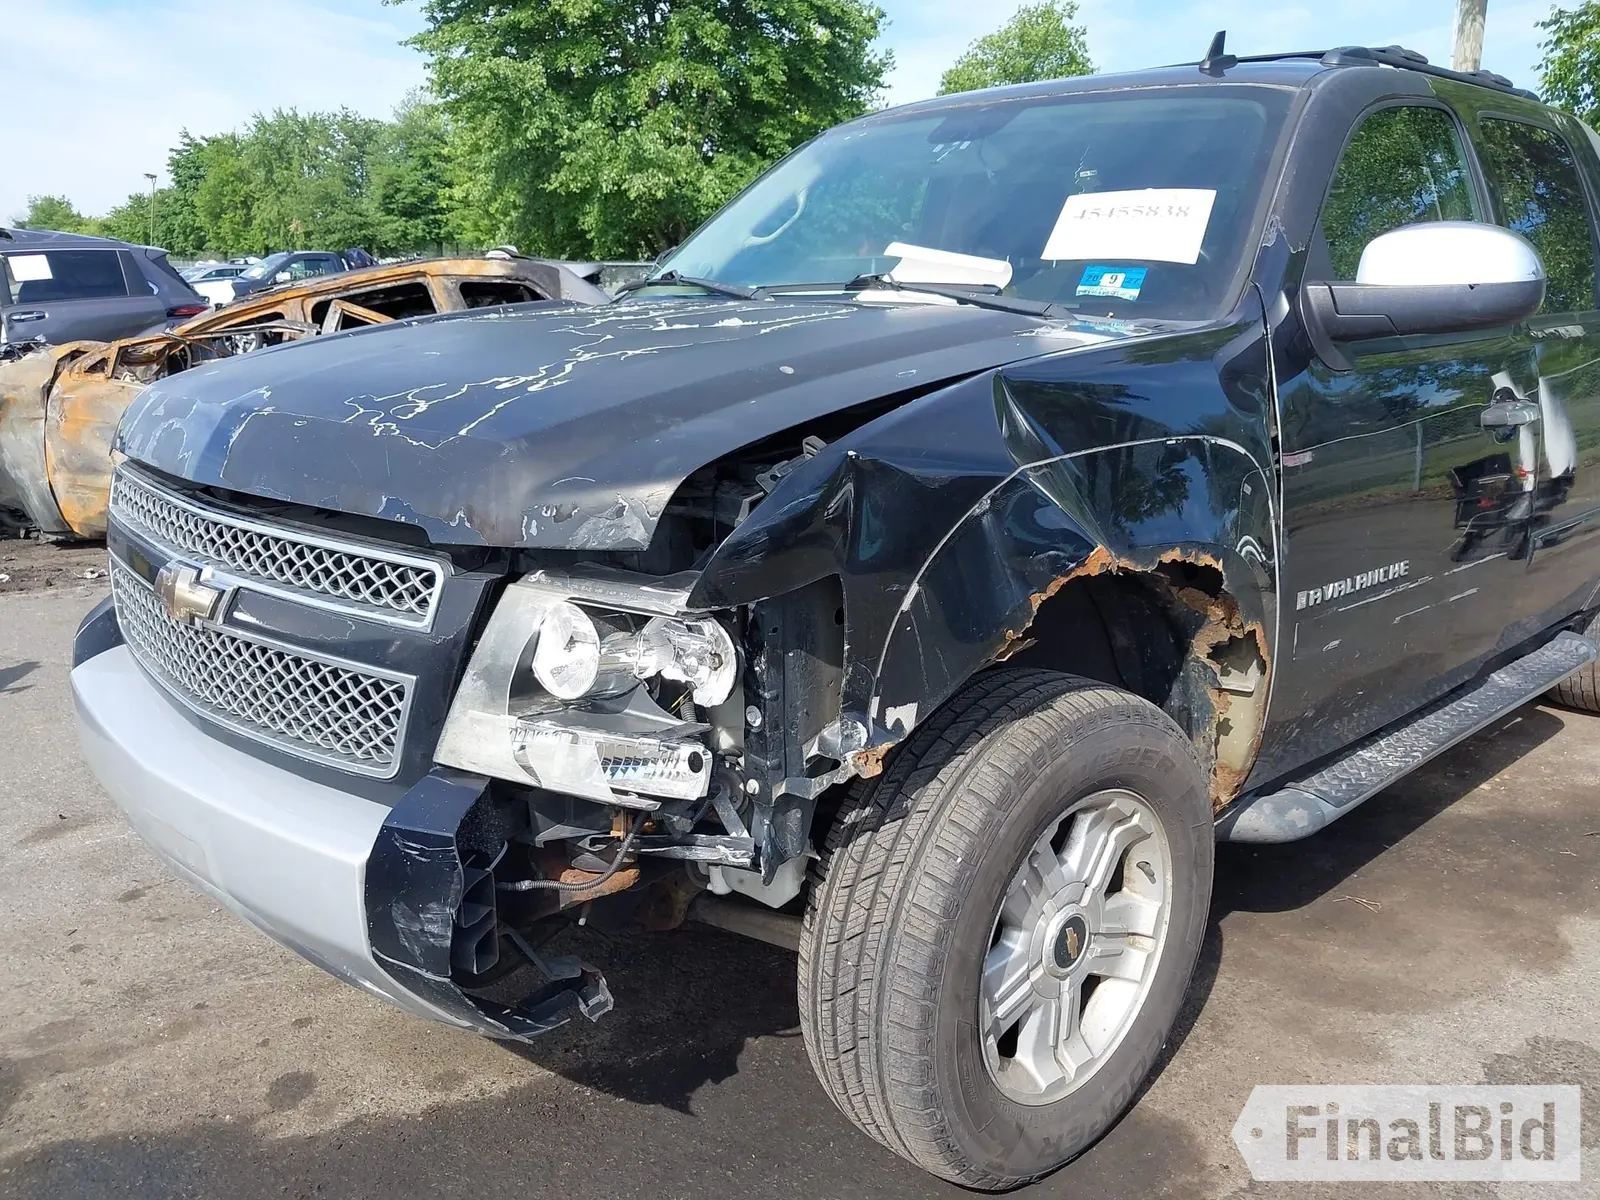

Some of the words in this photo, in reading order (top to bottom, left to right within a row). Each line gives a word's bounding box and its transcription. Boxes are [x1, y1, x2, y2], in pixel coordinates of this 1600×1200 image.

[1074, 205, 1190, 220] 45455838
[1086, 274, 1099, 282] 20
[1109, 274, 1118, 284] 9
[1308, 560, 1410, 606] AVALANCHE
